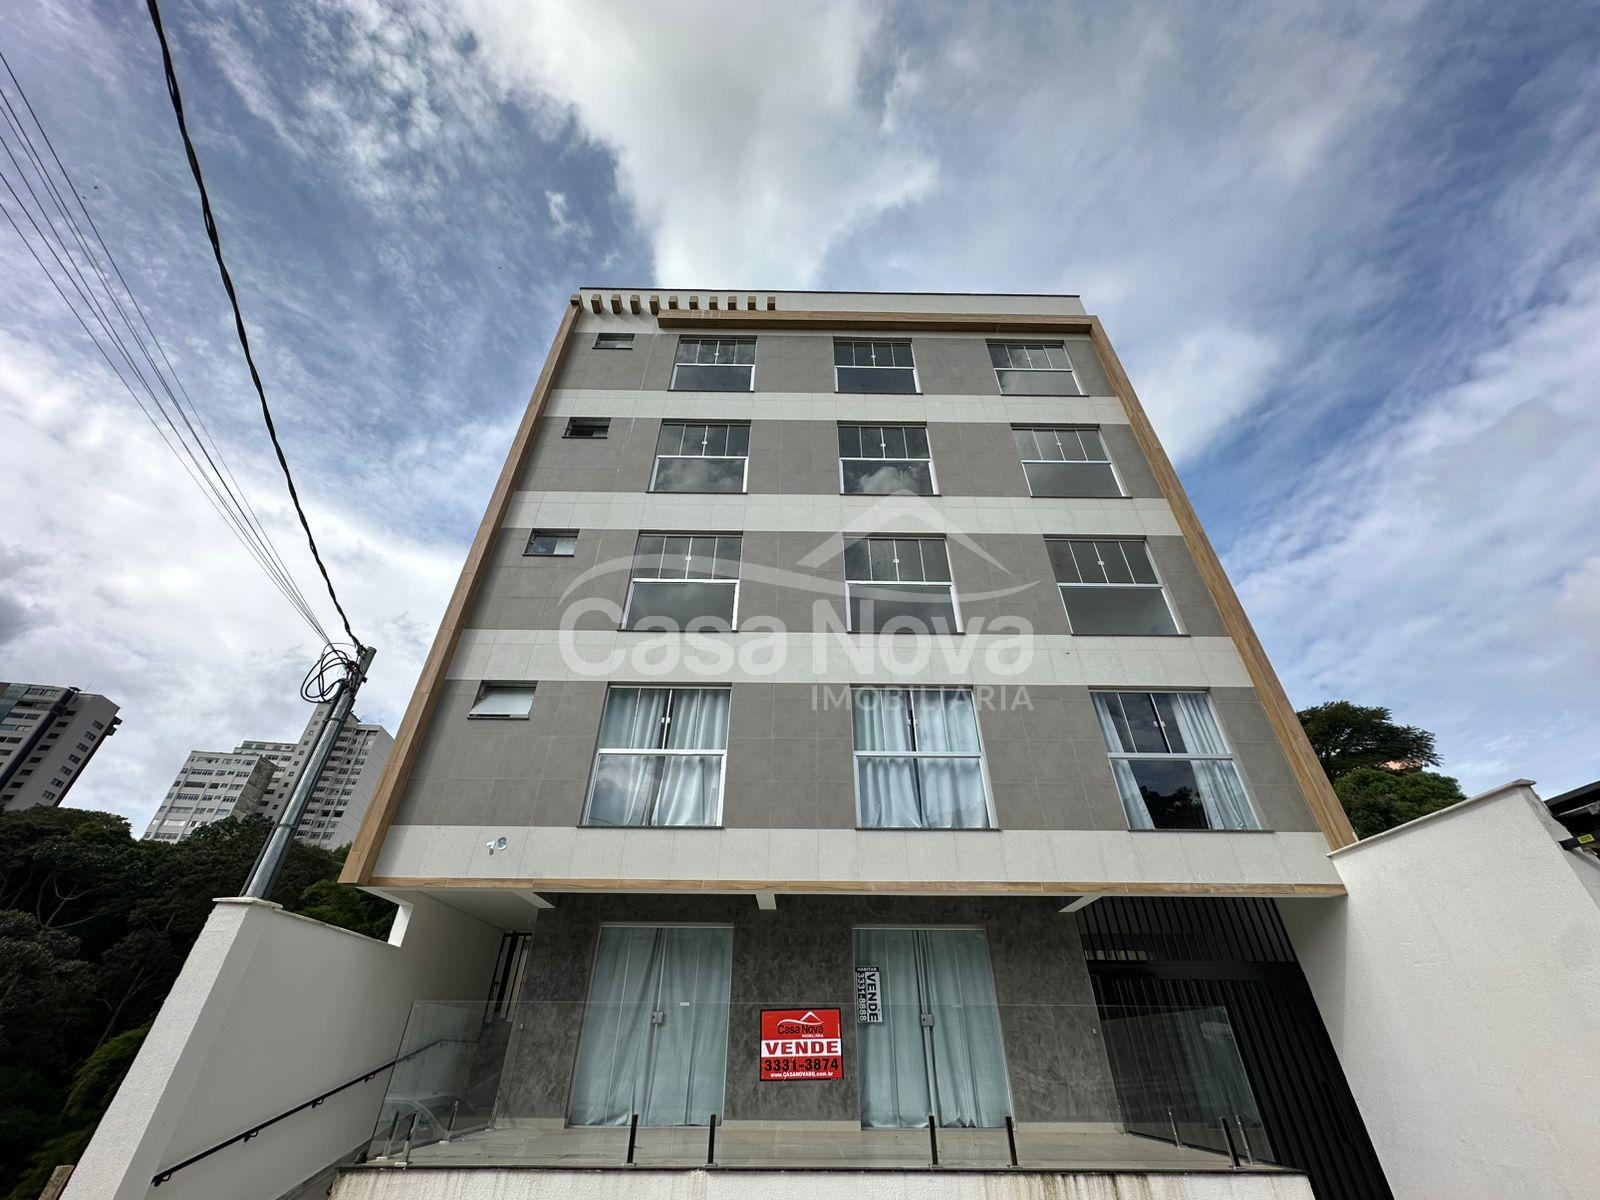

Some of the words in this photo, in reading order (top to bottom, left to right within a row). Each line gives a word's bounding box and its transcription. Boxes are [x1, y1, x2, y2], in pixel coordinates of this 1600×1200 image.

[857, 972, 866, 1021] 3331-8888
[867, 973, 879, 1022] VENDE
[777, 1025, 800, 1035] Casa
[802, 1024, 824, 1034] Nova
[765, 1041, 838, 1055] VENDE
[765, 1058, 839, 1071] 3331-3874
